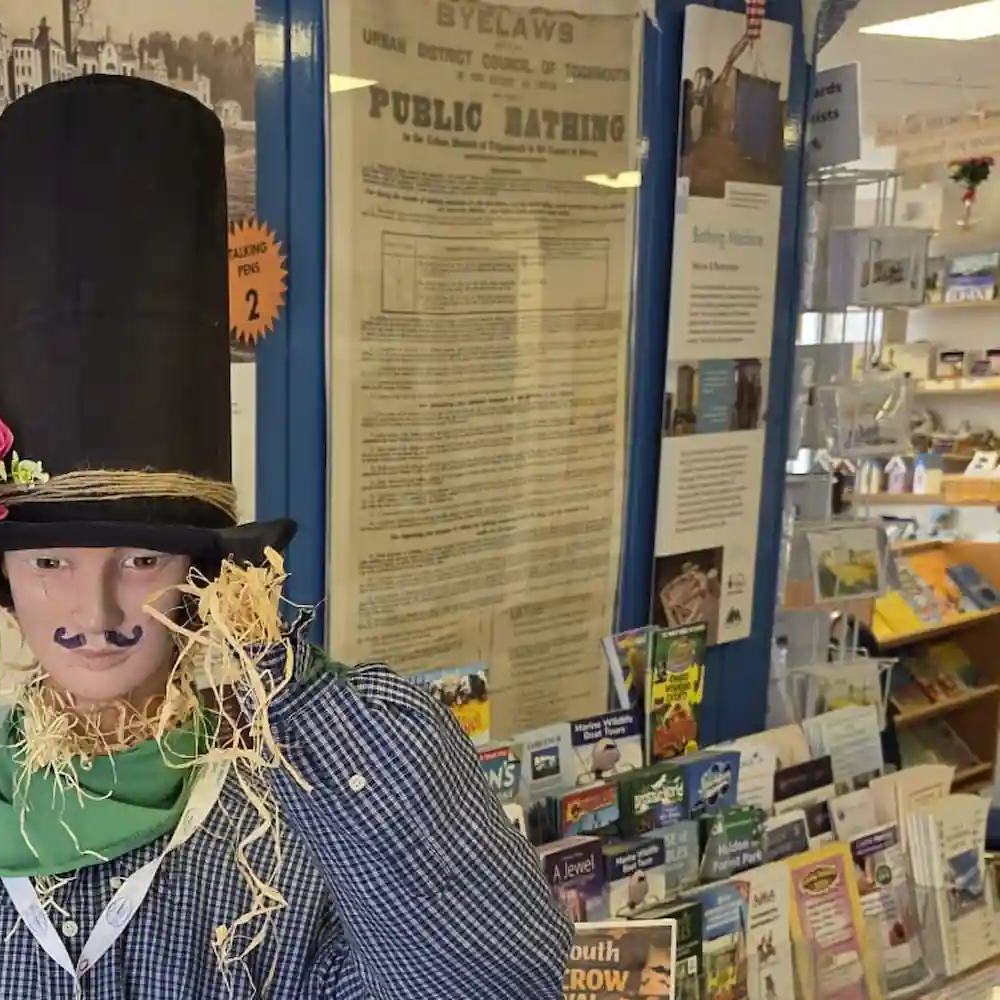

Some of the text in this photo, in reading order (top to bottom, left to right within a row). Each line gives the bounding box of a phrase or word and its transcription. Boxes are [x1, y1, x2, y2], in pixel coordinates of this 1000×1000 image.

[436, 2, 575, 45] BYELAWS
[362, 27, 407, 56] URBAN
[417, 43, 473, 66] DISTRICT
[482, 53, 533, 75] COUNCIL
[368, 86, 626, 144] PUBLIC BATHING
[245, 287, 260, 322] 2
[552, 852, 596, 881] A Jewel
[570, 940, 620, 963] outh
